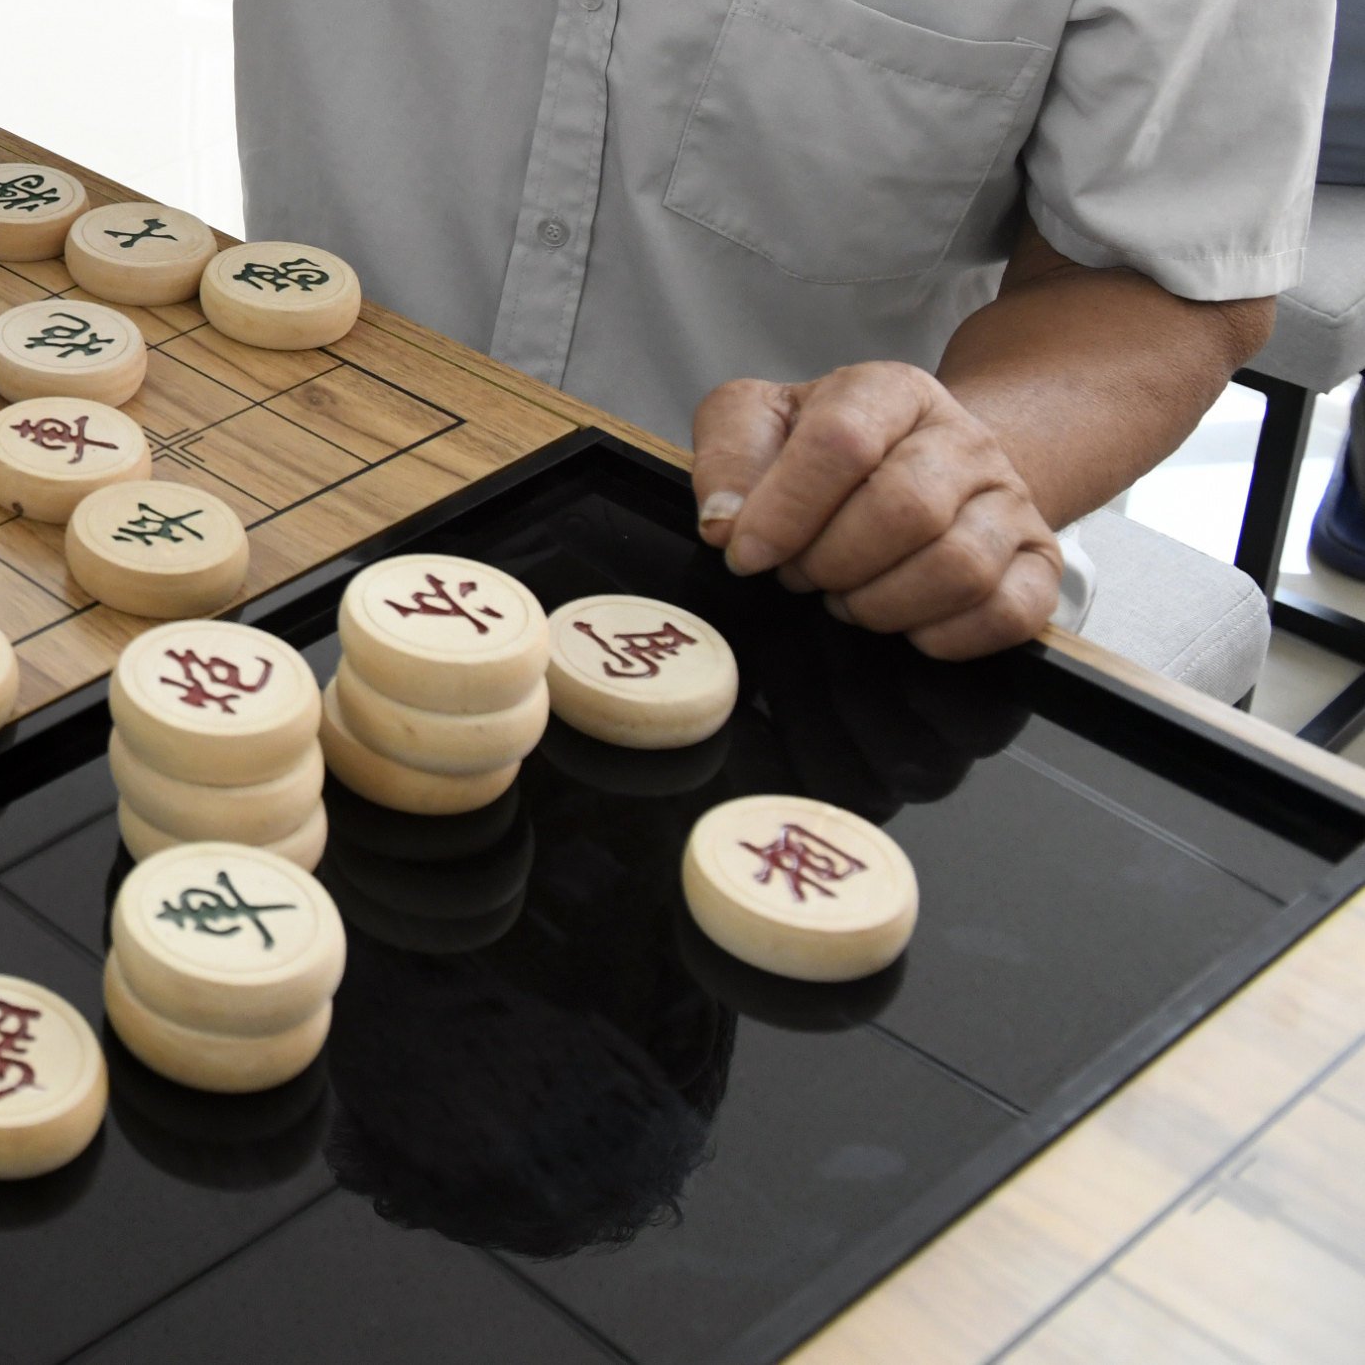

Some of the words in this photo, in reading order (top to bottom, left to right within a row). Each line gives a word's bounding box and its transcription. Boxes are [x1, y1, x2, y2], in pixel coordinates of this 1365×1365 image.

[103, 218, 178, 249] 士
[232, 257, 330, 293] 象
[9, 415, 119, 464] 車
[111, 502, 204, 547] 卒
[384, 573, 504, 635] 兵
[572, 621, 698, 679] 馬
[159, 649, 273, 714] 炮
[739, 823, 867, 901] 相
[156, 870, 296, 949] 車
